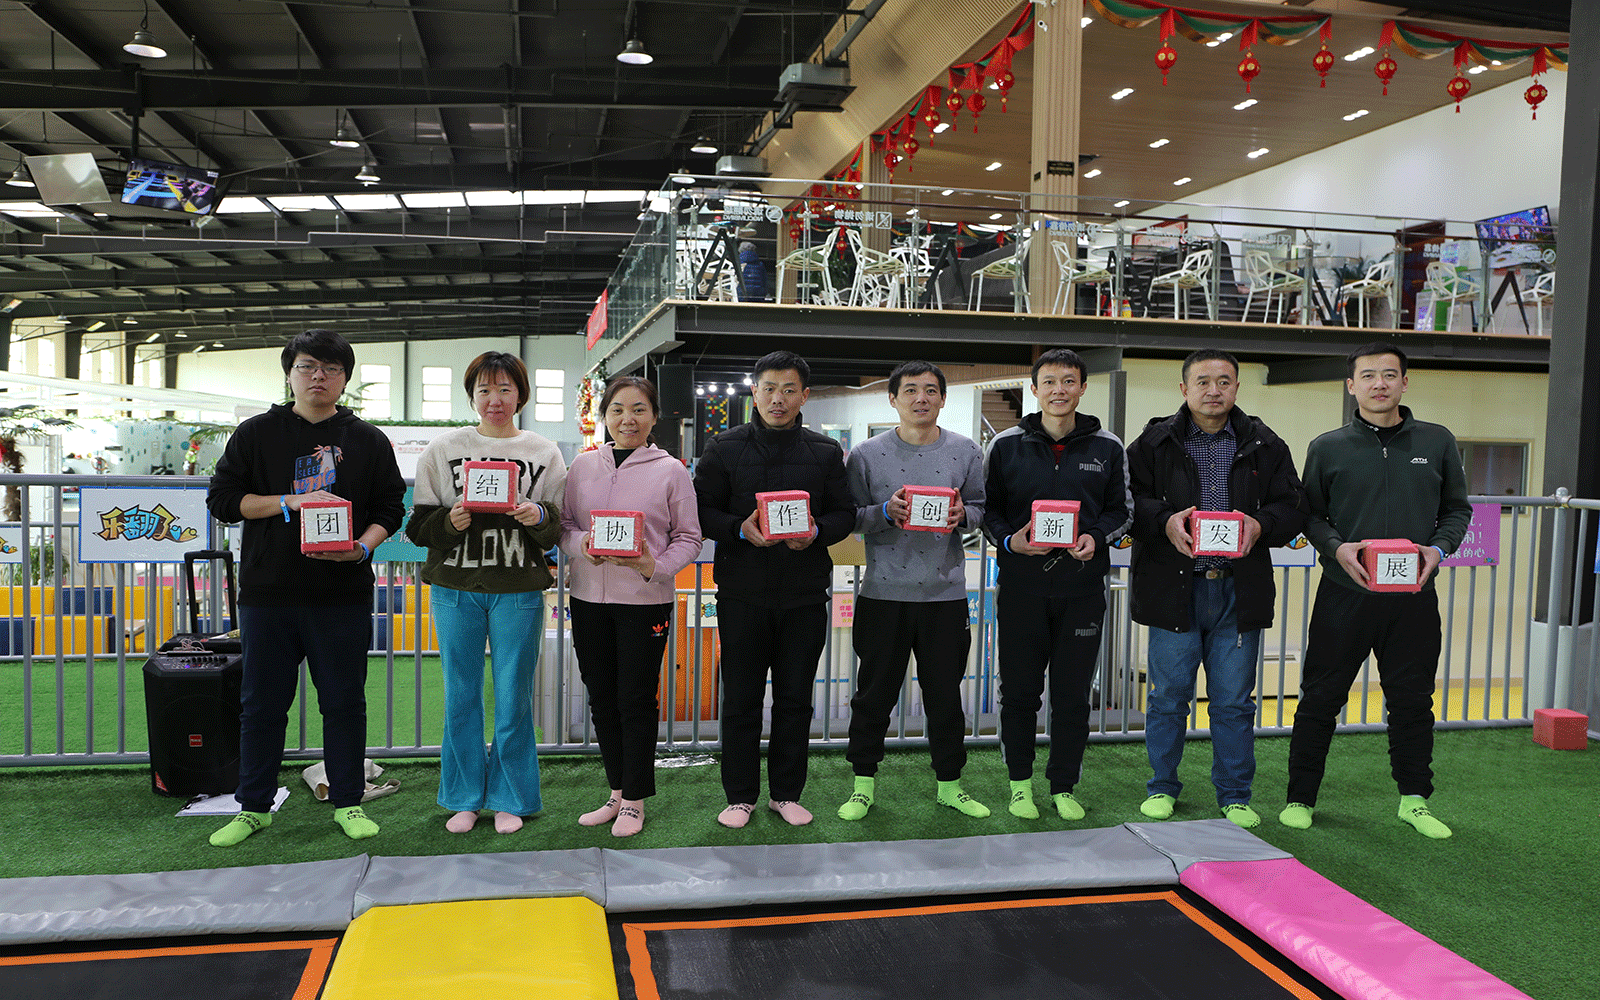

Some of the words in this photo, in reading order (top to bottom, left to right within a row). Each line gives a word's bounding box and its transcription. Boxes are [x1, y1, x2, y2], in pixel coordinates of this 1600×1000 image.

[1078, 462, 1102, 472] PUMA
[475, 474, 499, 496] 结
[777, 504, 798, 526] 作
[920, 500, 942, 523] 创
[316, 512, 339, 535] 团
[605, 520, 627, 542] 协
[1042, 516, 1065, 539] 新
[1210, 524, 1232, 547] 发
[1384, 556, 1408, 579] 展
